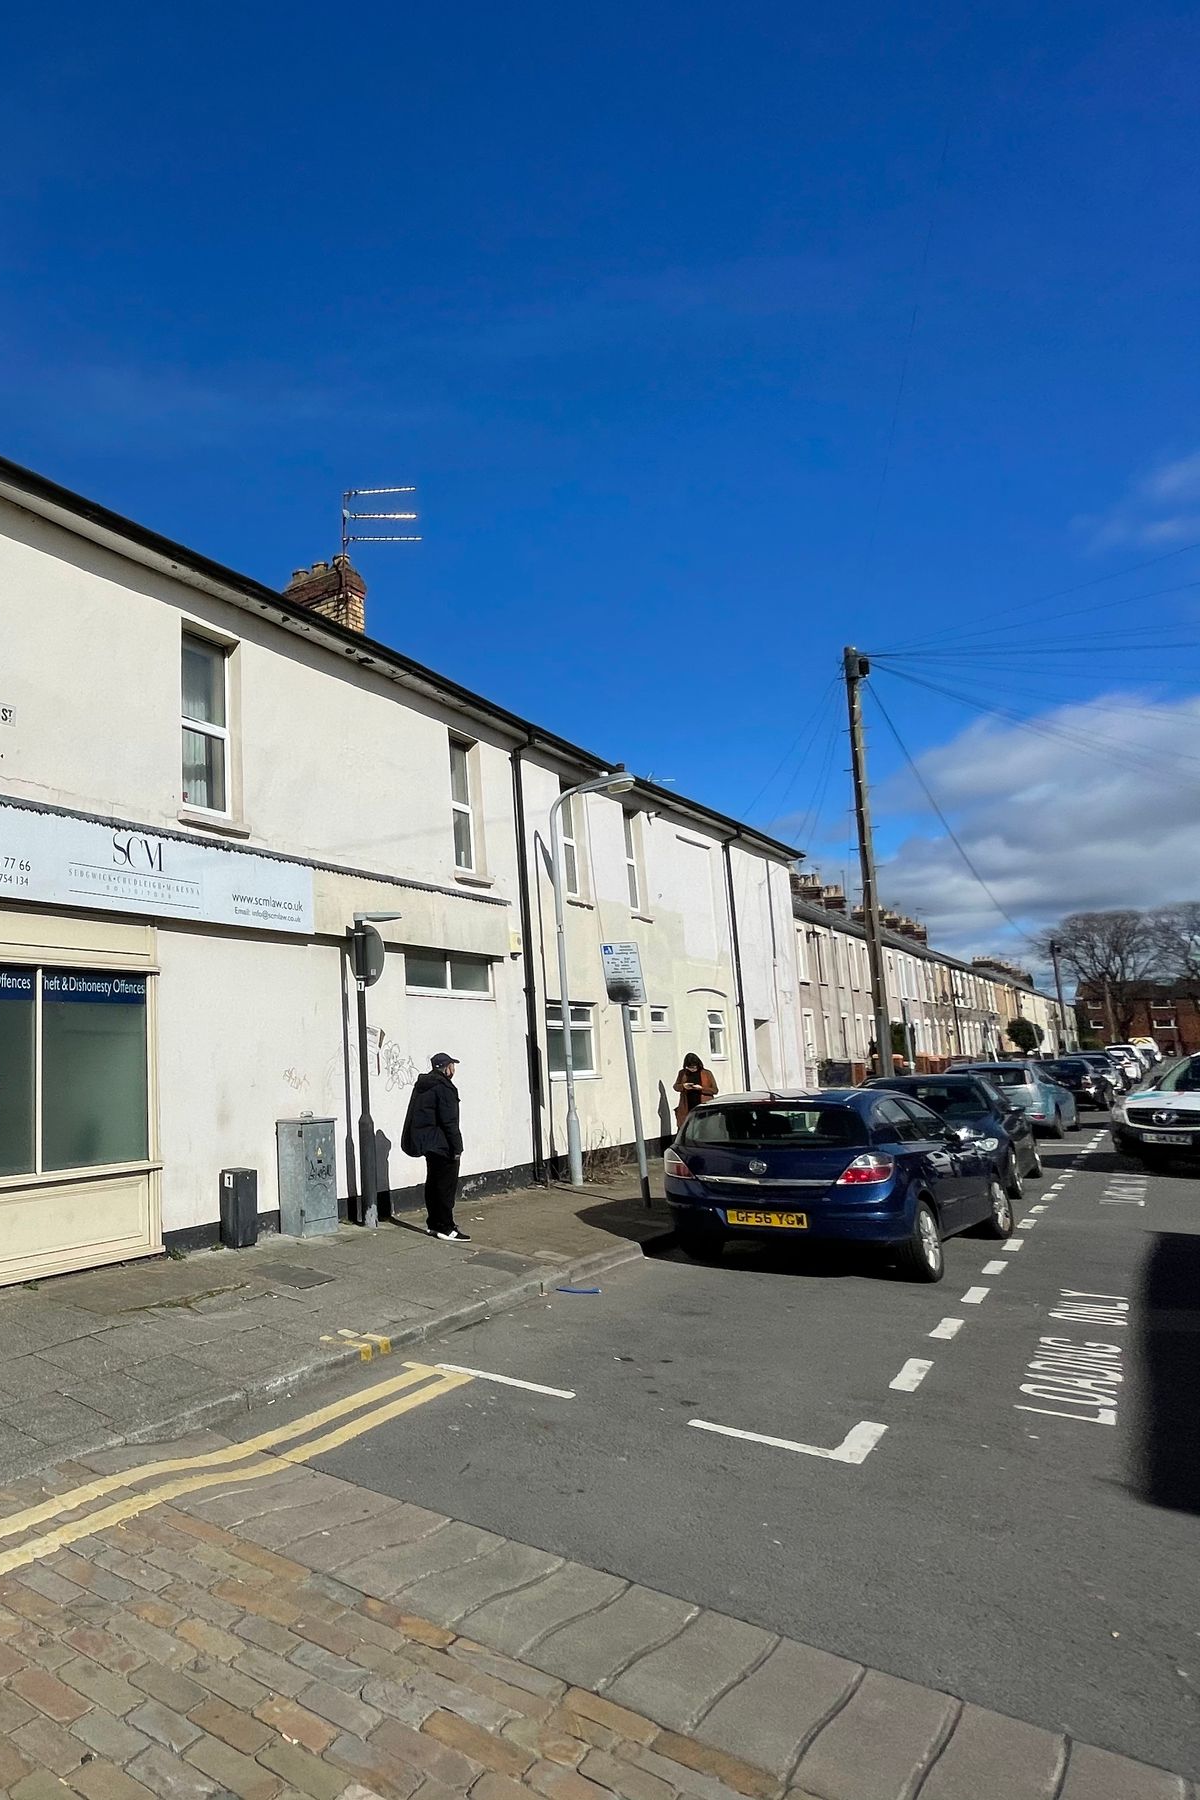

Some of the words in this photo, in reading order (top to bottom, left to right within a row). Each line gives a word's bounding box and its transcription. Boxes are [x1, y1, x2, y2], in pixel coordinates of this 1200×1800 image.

[112, 832, 164, 872] SCM
[4, 857, 16, 869] 77
[19, 860, 31, 872] 66
[16, 876, 29, 886] 134
[231, 893, 304, 912] www.scmlaw.co.uk
[61, 977, 69, 991] &
[69, 977, 112, 997] Dishonesty
[113, 979, 145, 994] Offences
[736, 1212, 772, 1224] GF56
[776, 1213, 804, 1225] YGW
[1048, 1288, 1129, 1325] ONLY
[1012, 1336, 1123, 1426] LOADING
